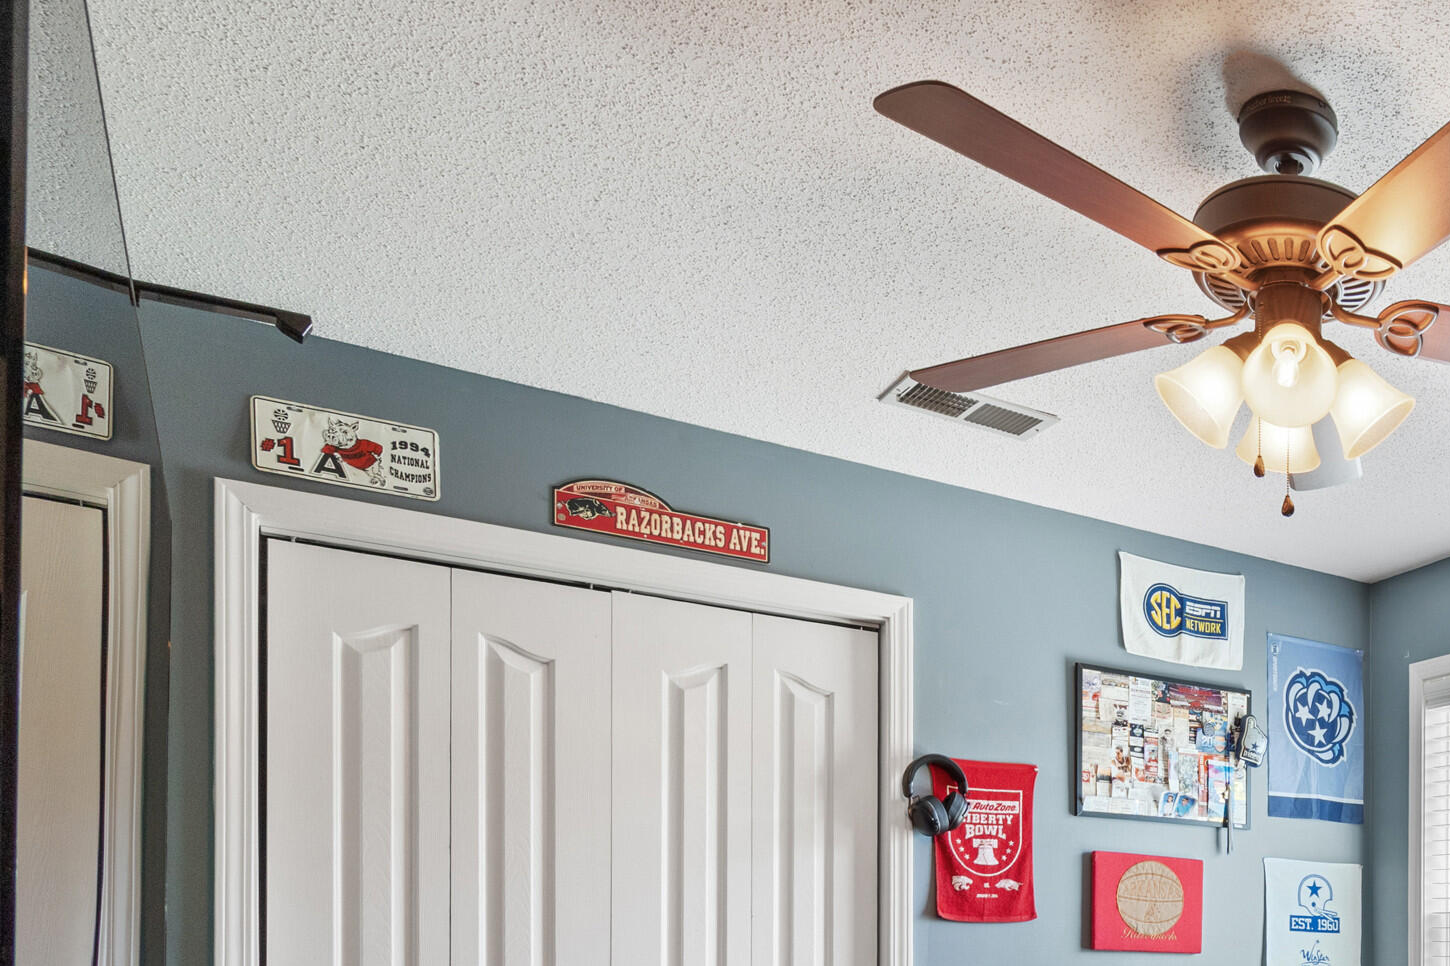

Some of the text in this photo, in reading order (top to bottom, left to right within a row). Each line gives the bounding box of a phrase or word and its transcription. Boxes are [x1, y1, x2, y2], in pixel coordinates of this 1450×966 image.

[260, 436, 300, 467] #1
[390, 440, 431, 458] 1994
[390, 454, 430, 470] NATIONAL
[389, 466, 432, 484] CHAMPIONS
[575, 485, 613, 493] UNIVERSITY
[616, 506, 766, 555] RAZORBACKS AVE.
[1150, 590, 1182, 630] SEC
[1185, 601, 1221, 618] ESPN
[1185, 618, 1221, 634] NETWORK
[972, 801, 1017, 812] AutoZone
[965, 823, 1007, 840] BOWL
[1291, 918, 1339, 931] EST. 1960
